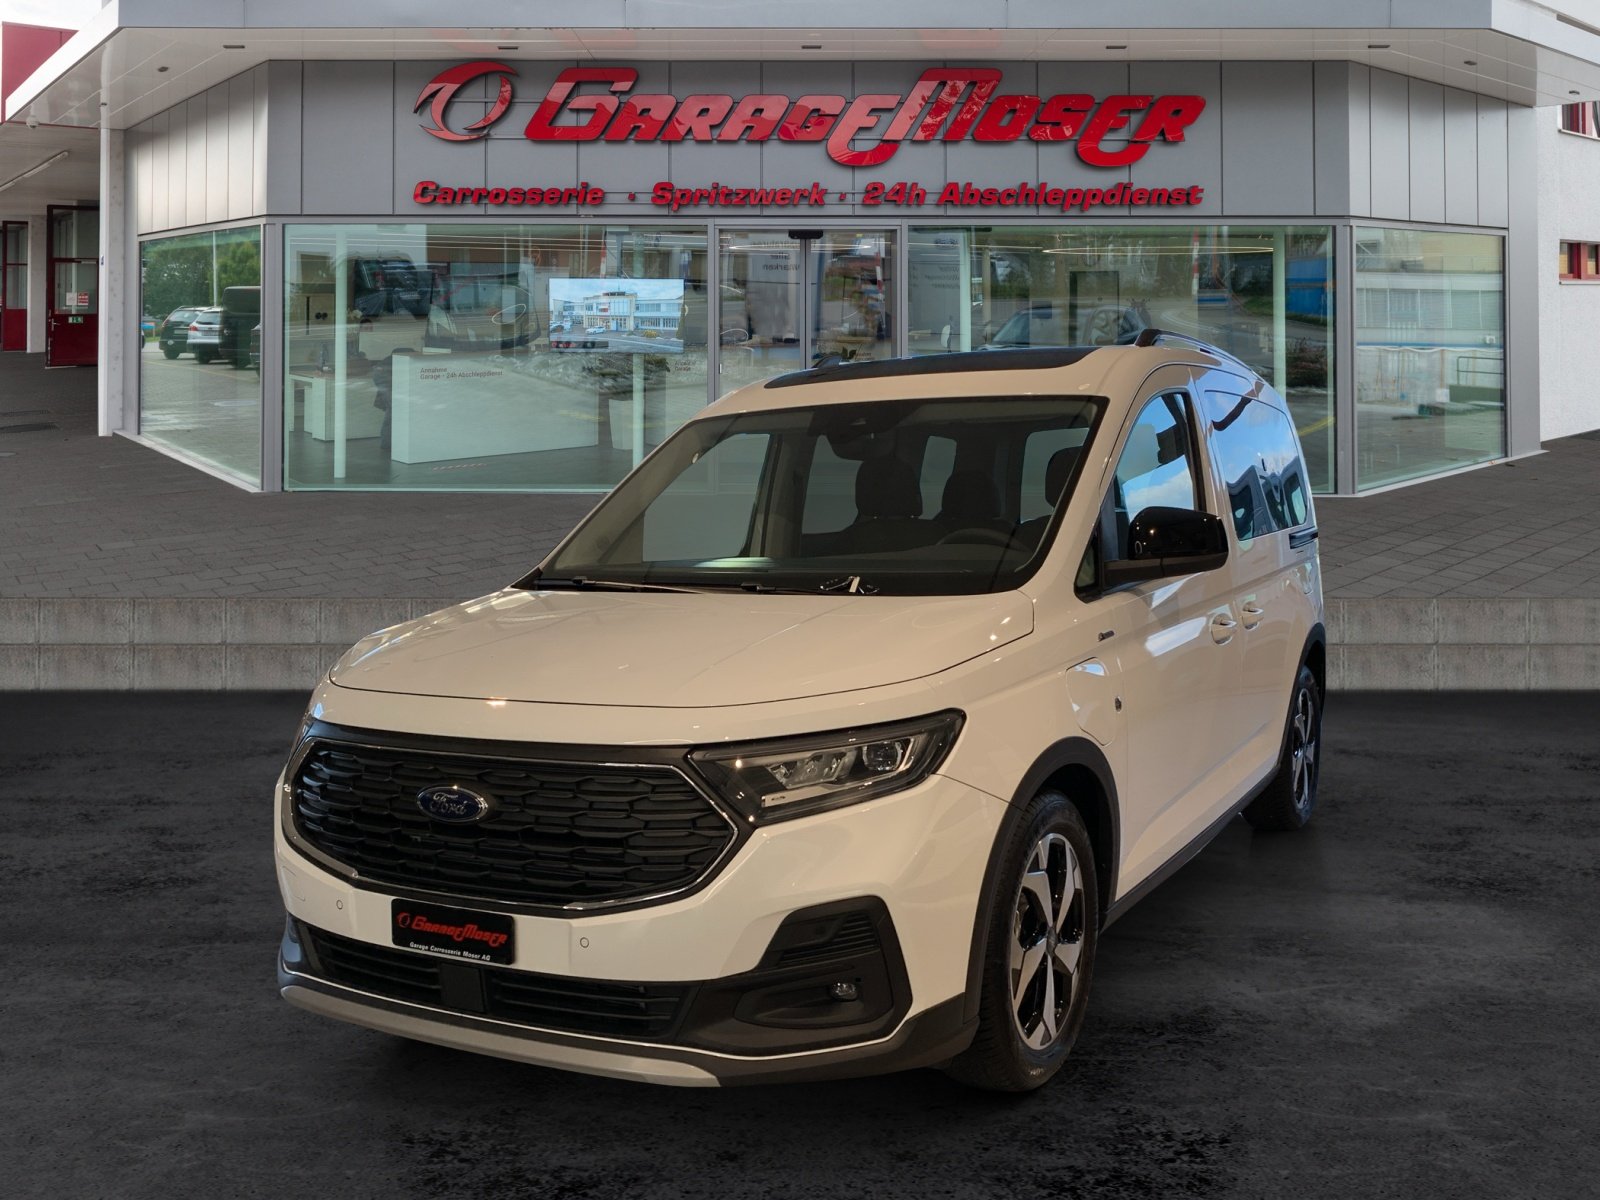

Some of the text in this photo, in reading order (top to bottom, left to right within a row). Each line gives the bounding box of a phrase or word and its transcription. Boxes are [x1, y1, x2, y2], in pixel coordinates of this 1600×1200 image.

[413, 181, 1204, 212] Carrosserie Spritzwerk 24h Abschleppdienst
[420, 373, 440, 381] Garage
[431, 792, 467, 815] Ford
[409, 941, 428, 951] Garage
[430, 945, 461, 956] Carrosserie
[463, 951, 480, 960] Moser
